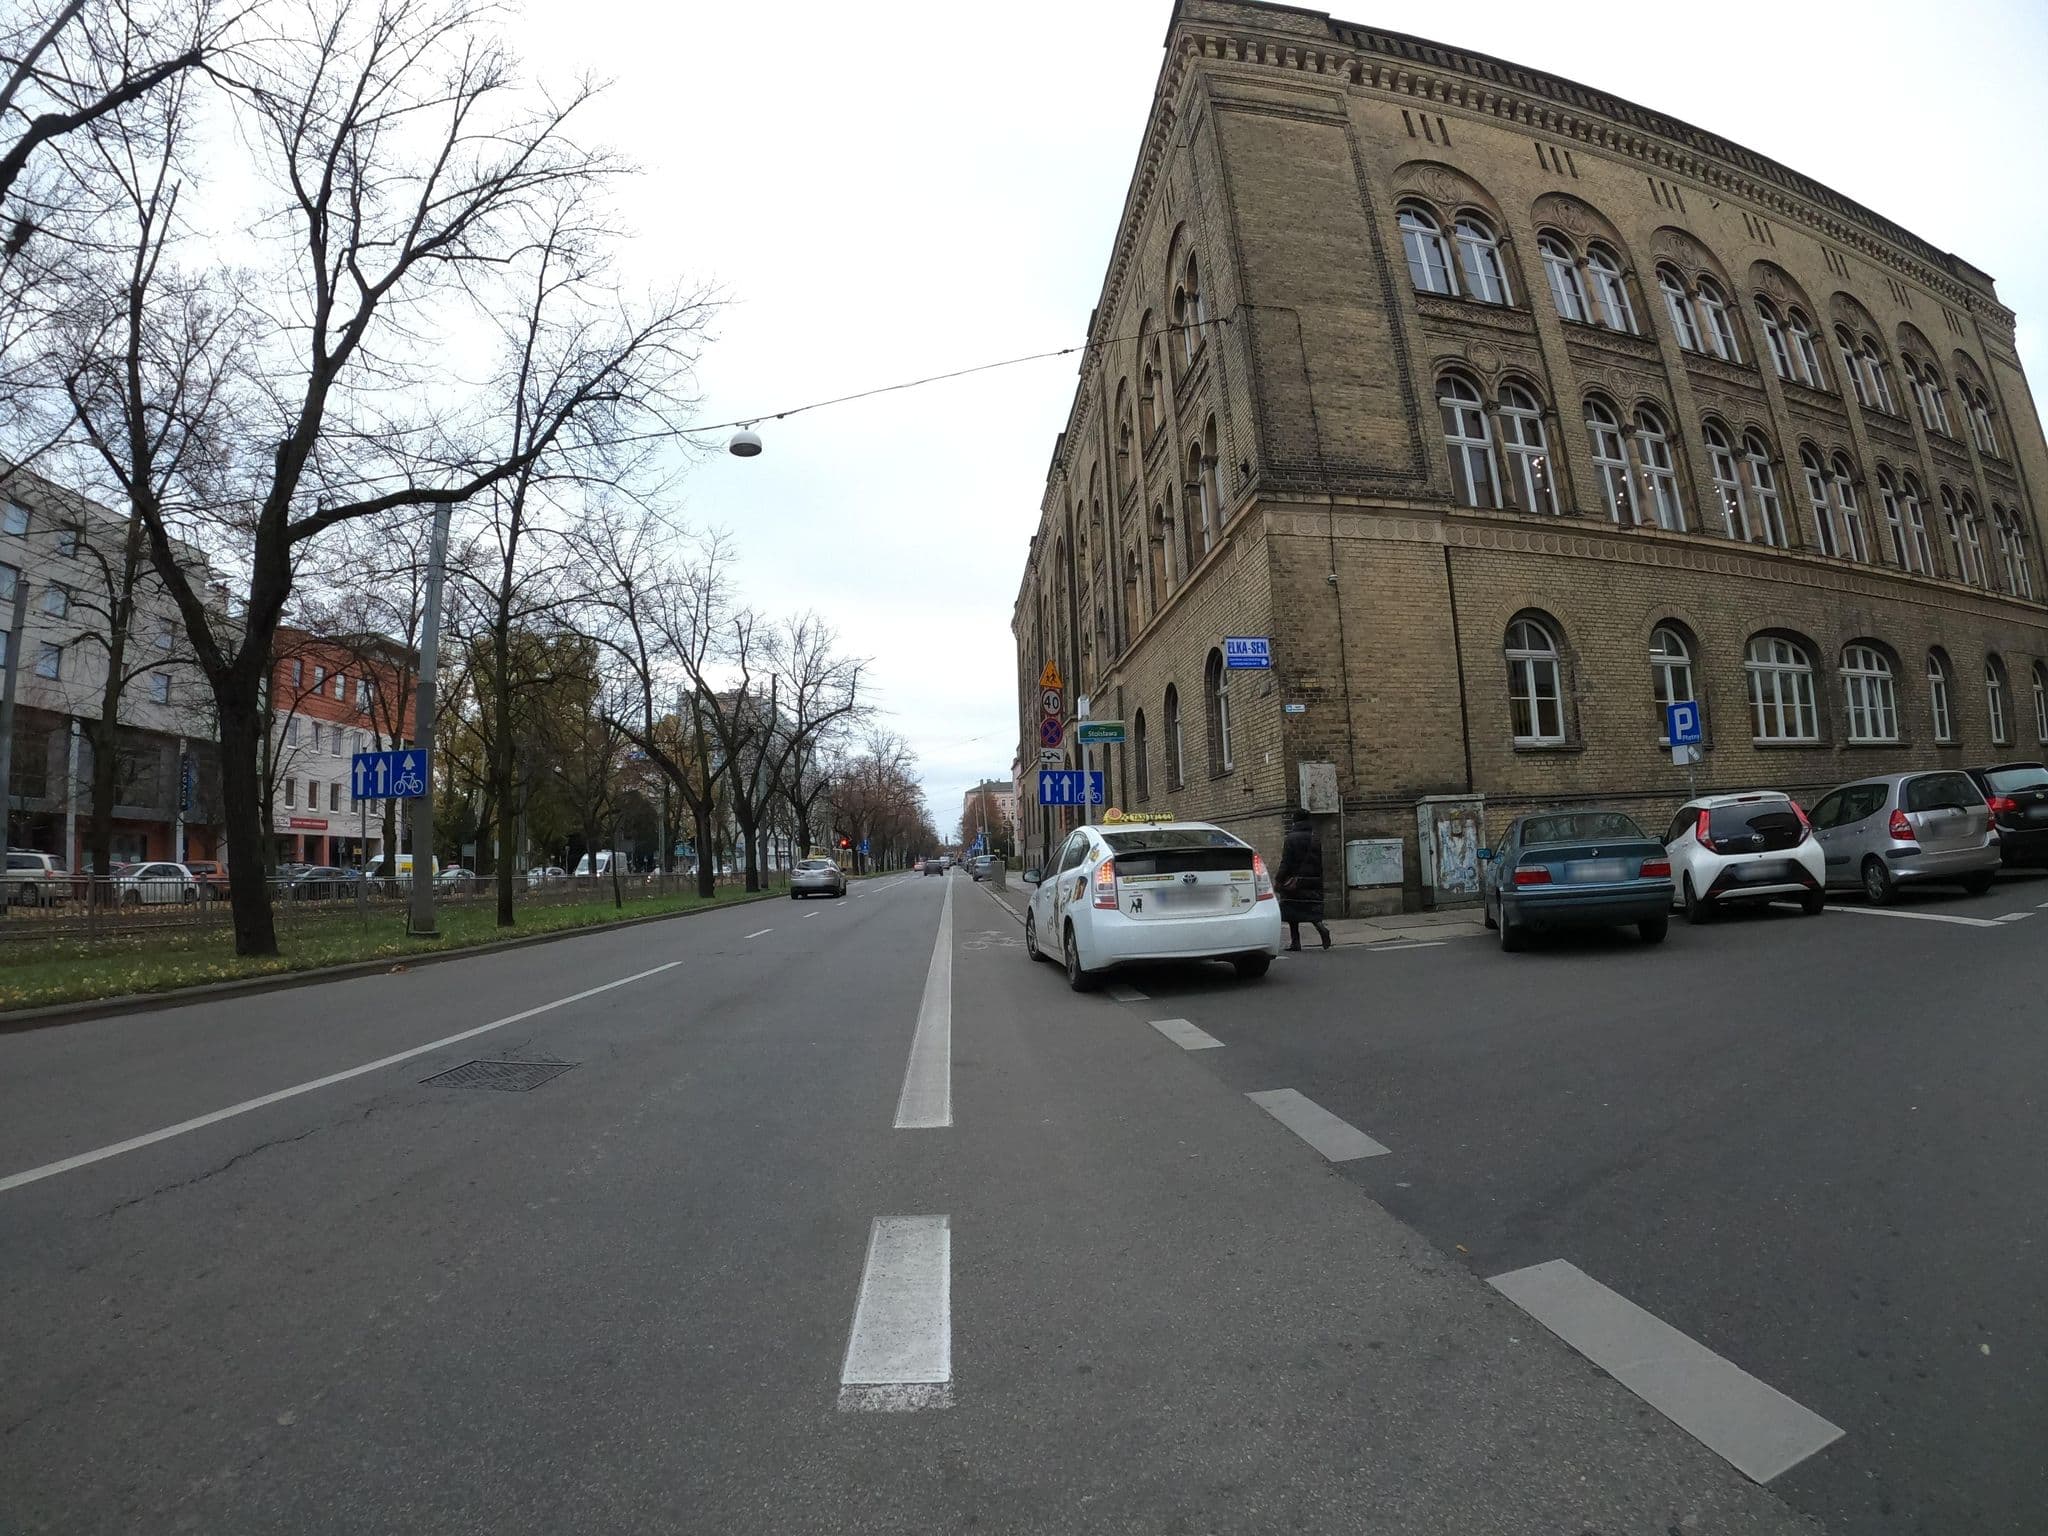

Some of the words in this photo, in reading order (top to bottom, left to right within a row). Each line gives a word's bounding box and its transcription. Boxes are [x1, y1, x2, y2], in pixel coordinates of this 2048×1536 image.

[1227, 641, 1267, 654] ELKA-SEN
[1043, 695, 1060, 709] 40
[1674, 708, 1694, 740] P
